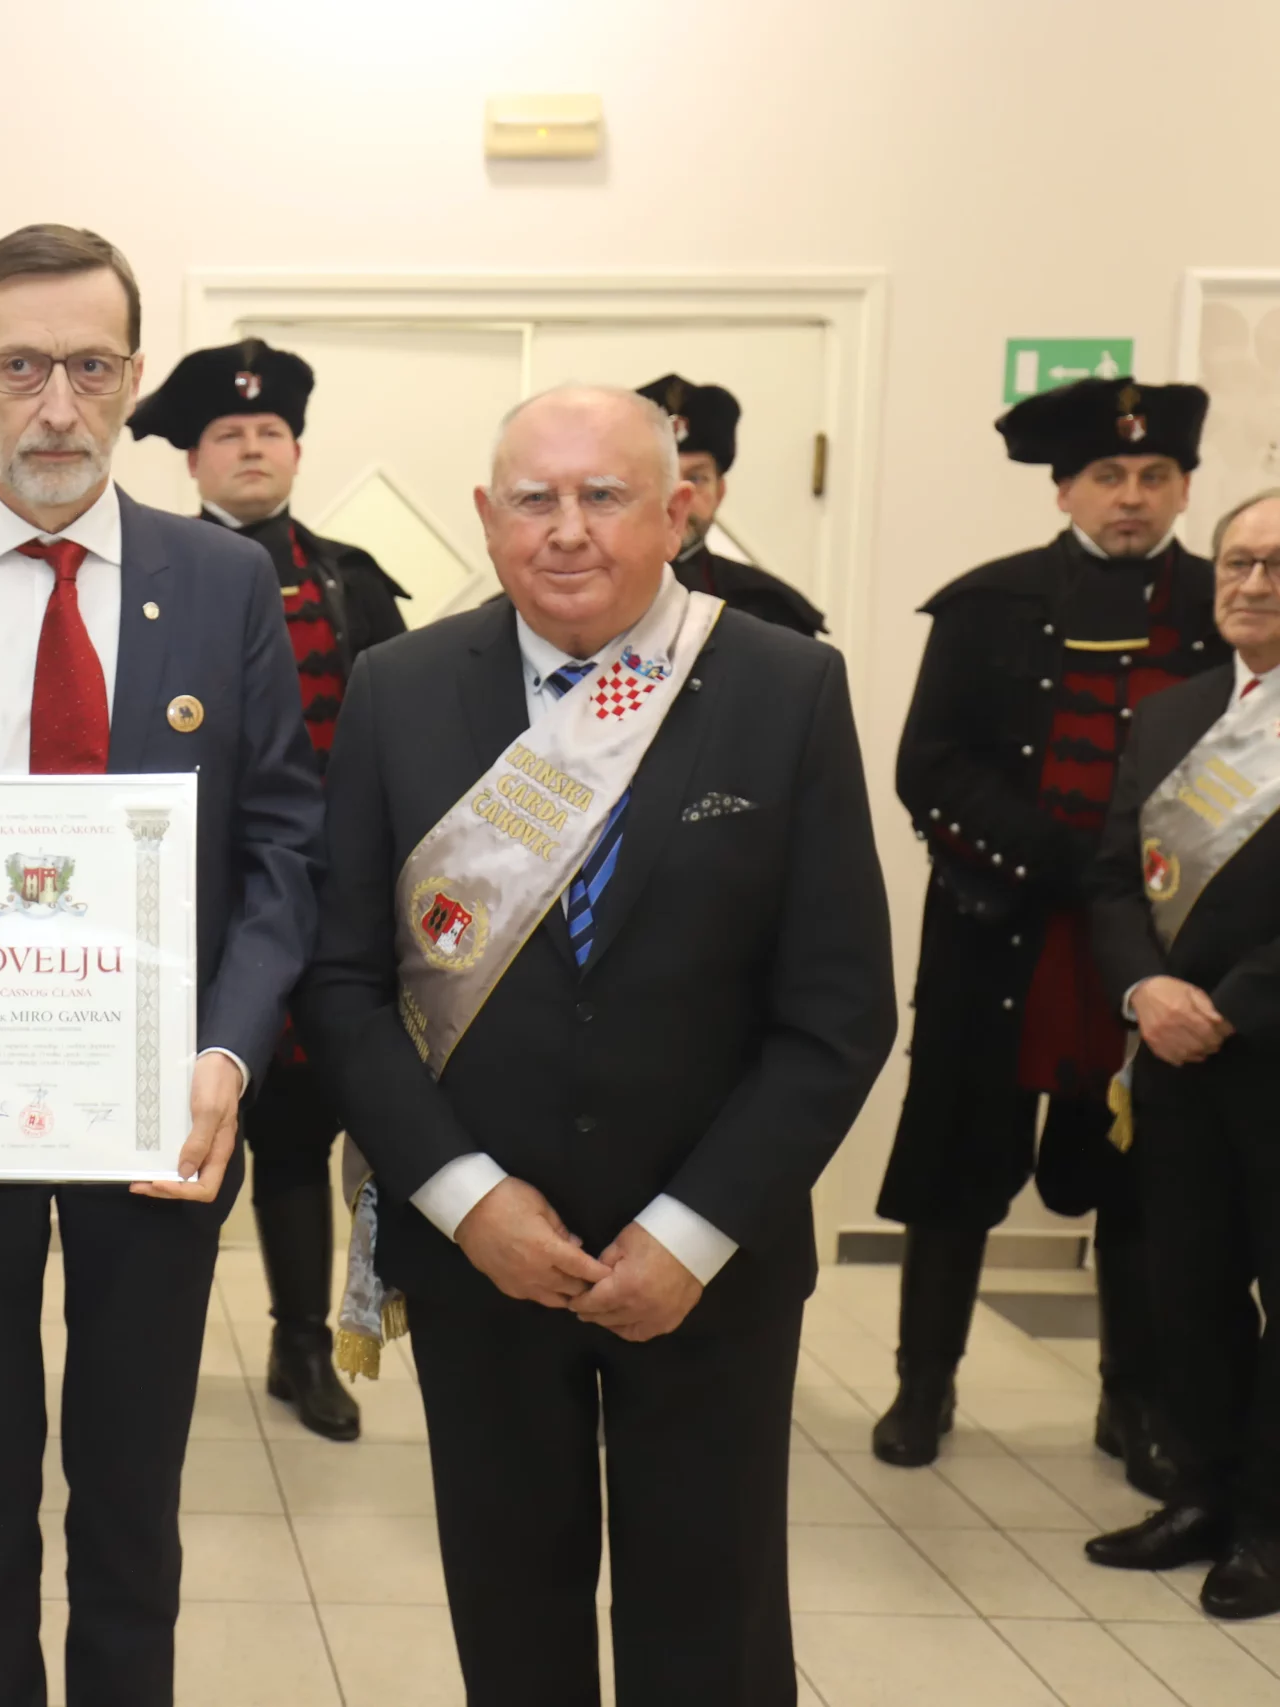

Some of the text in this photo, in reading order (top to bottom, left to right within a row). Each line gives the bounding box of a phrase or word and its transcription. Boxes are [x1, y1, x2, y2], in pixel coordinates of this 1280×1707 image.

[496, 773, 569, 832] GARDA
[506, 743, 594, 812] ZRINSKA
[18, 824, 58, 835] GARDA
[471, 787, 561, 862] ČAKOVEC
[10, 1010, 53, 1023] MIRO
[58, 1010, 123, 1023] GAVRAN
